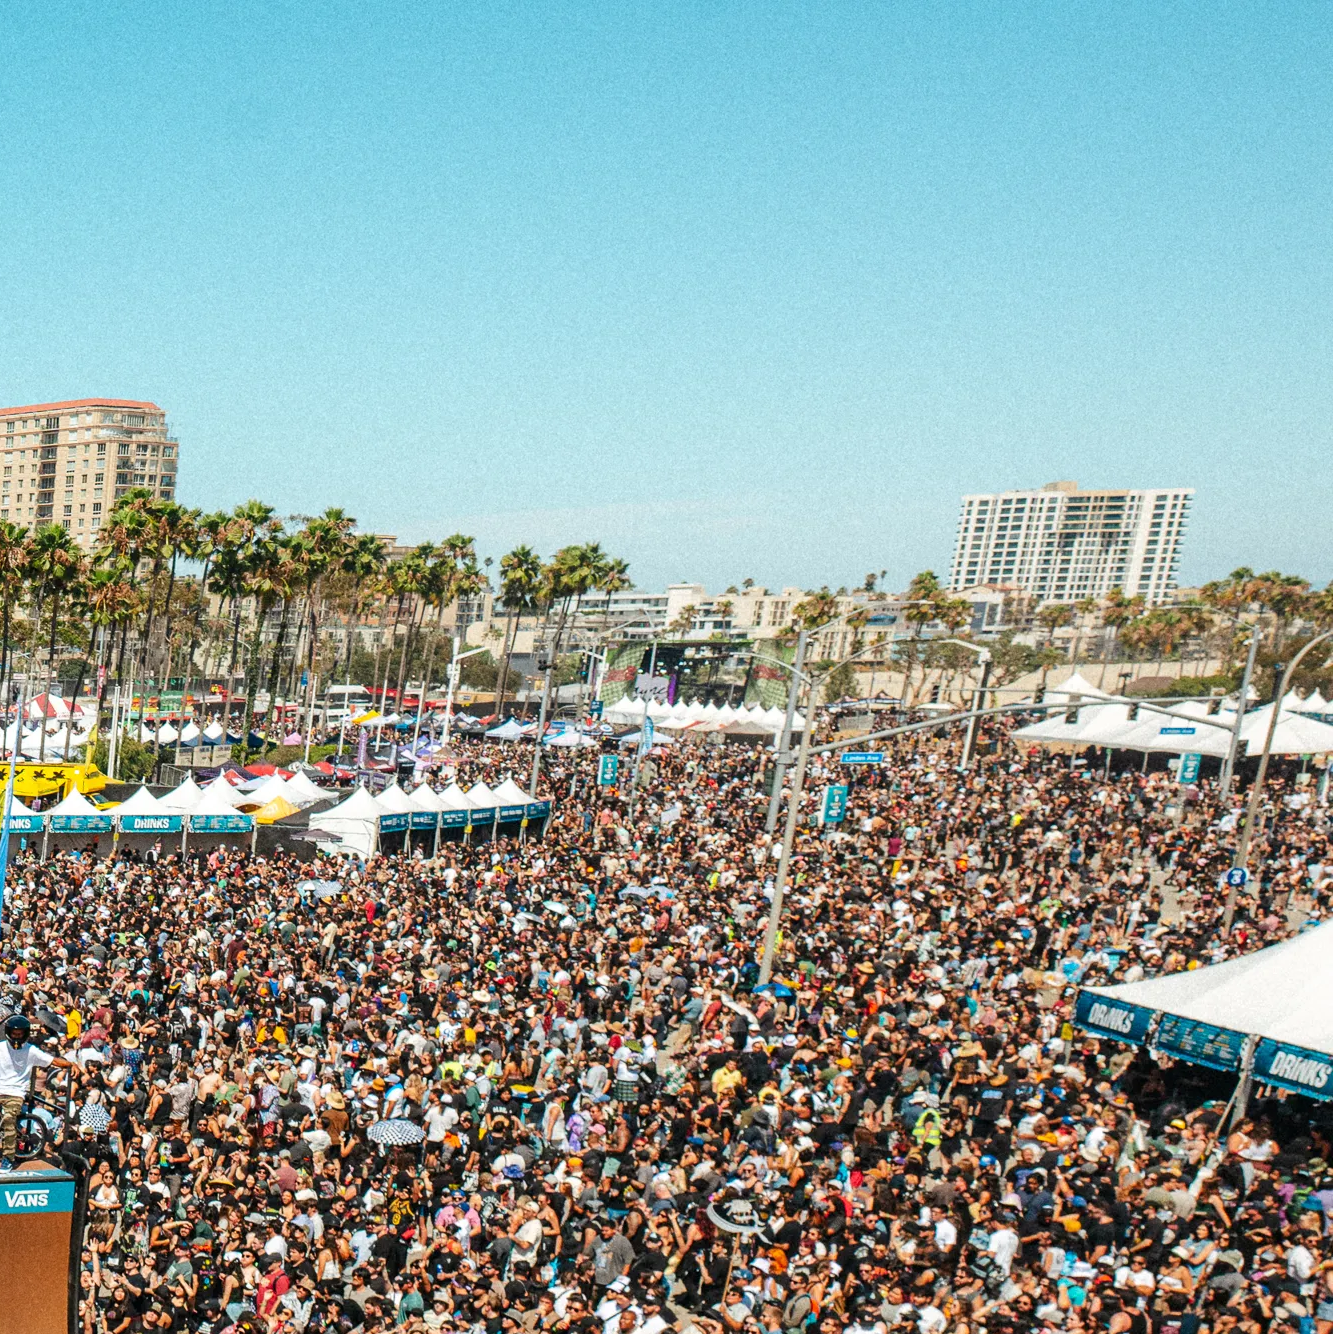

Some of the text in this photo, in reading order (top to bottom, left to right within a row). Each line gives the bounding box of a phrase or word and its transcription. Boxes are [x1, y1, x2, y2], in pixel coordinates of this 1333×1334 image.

[134, 818, 169, 829] DRINKS
[1087, 1002, 1135, 1034] DRINKS
[1268, 1051, 1333, 1089] DRINKS
[5, 1190, 50, 1207] VANS
